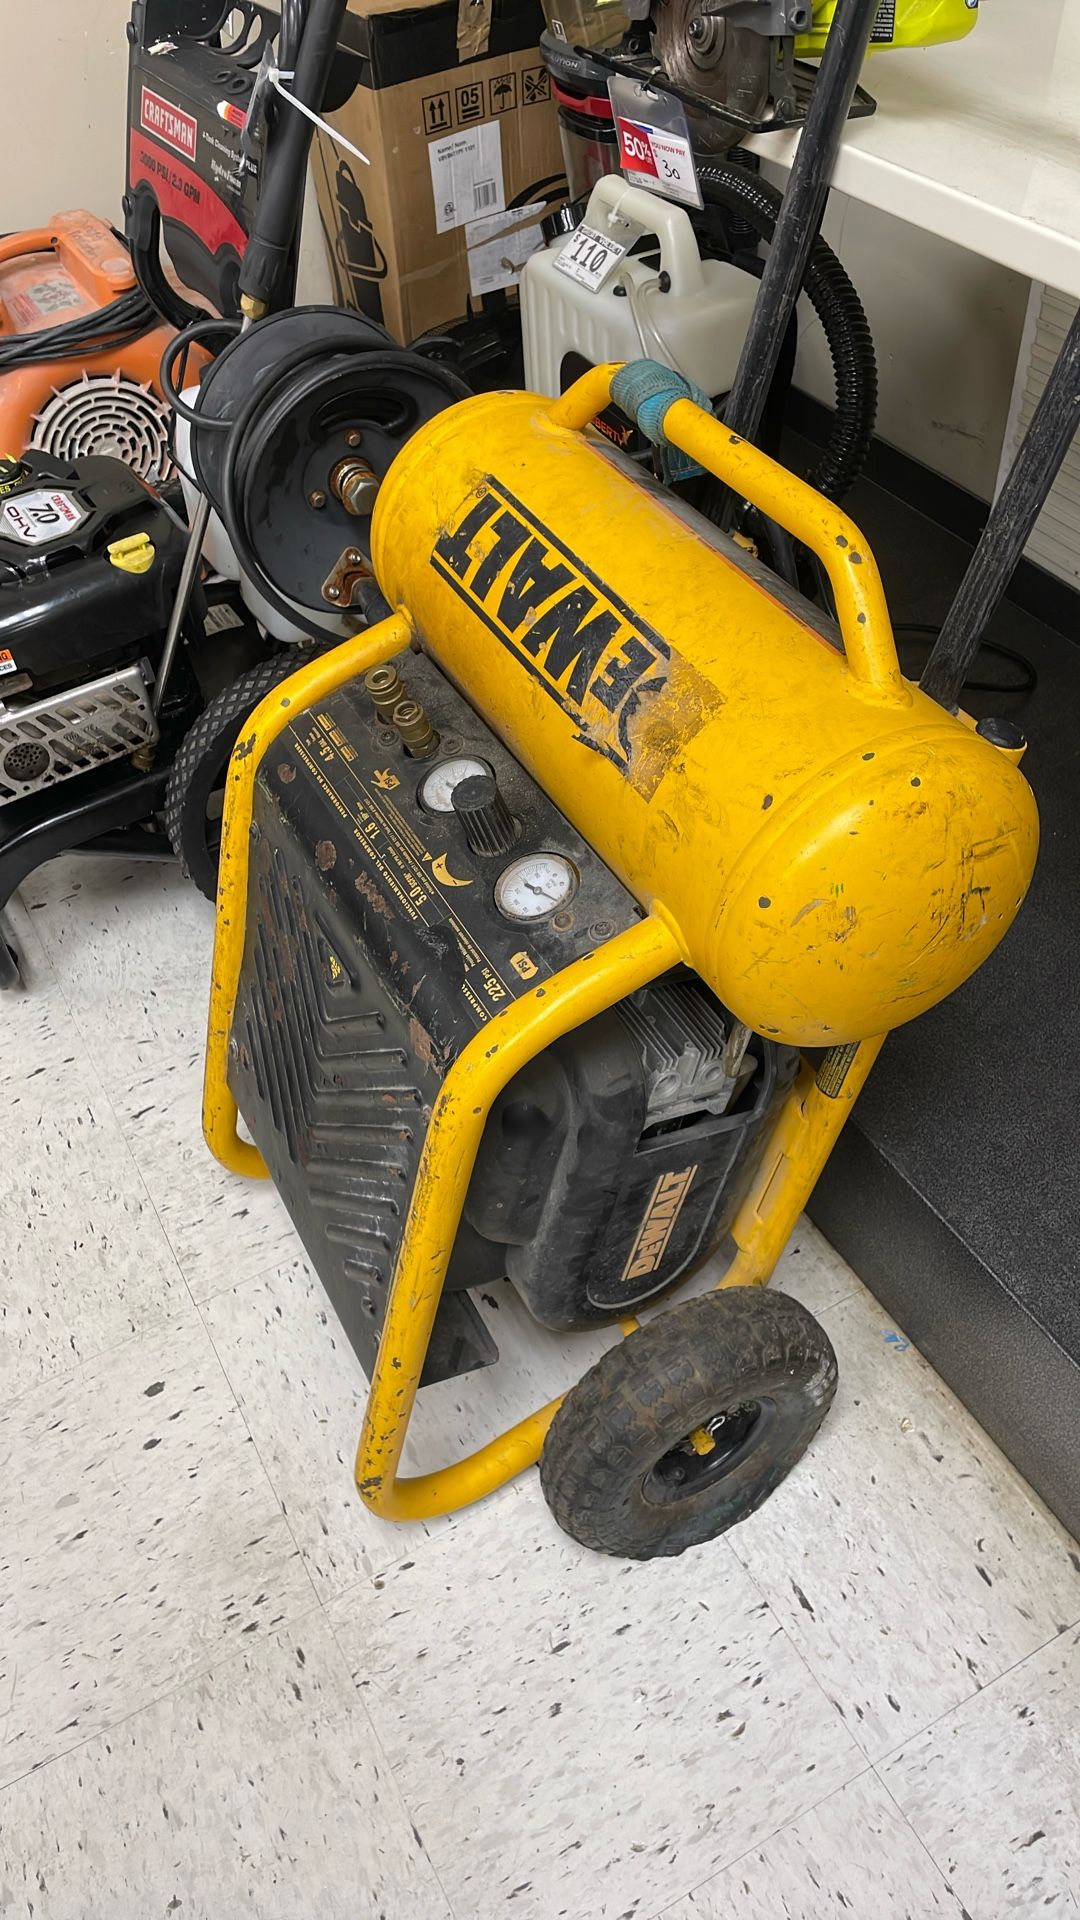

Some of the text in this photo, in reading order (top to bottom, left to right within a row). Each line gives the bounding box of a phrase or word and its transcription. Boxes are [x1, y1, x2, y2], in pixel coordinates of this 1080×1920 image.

[461, 87, 479, 107] 05
[144, 98, 194, 150] CRAFTSMAN
[622, 131, 652, 160] 50%
[662, 143, 675, 154] NOW
[675, 146, 686, 156] PAY
[245, 159, 258, 174] PLUS
[662, 160, 681, 179] 30
[6, 506, 37, 537] OHV
[28, 503, 60, 524] 7.0
[293, 742, 318, 775] COMPRESSEUR
[318, 745, 336, 763] 4.5
[383, 775, 395, 788] PSI
[320, 782, 348, 818] PERFORMANCE
[363, 821, 382, 840] 1.6
[352, 827, 377, 860] COMPRESOR
[374, 859, 384, 871] DEL
[381, 870, 418, 920] FUNCIONAMIENTO
[408, 885, 428, 906] 5.0
[516, 957, 531, 973] PSI
[480, 966, 506, 1002] 225 PSI
[626, 1169, 691, 1280] DEWALT
